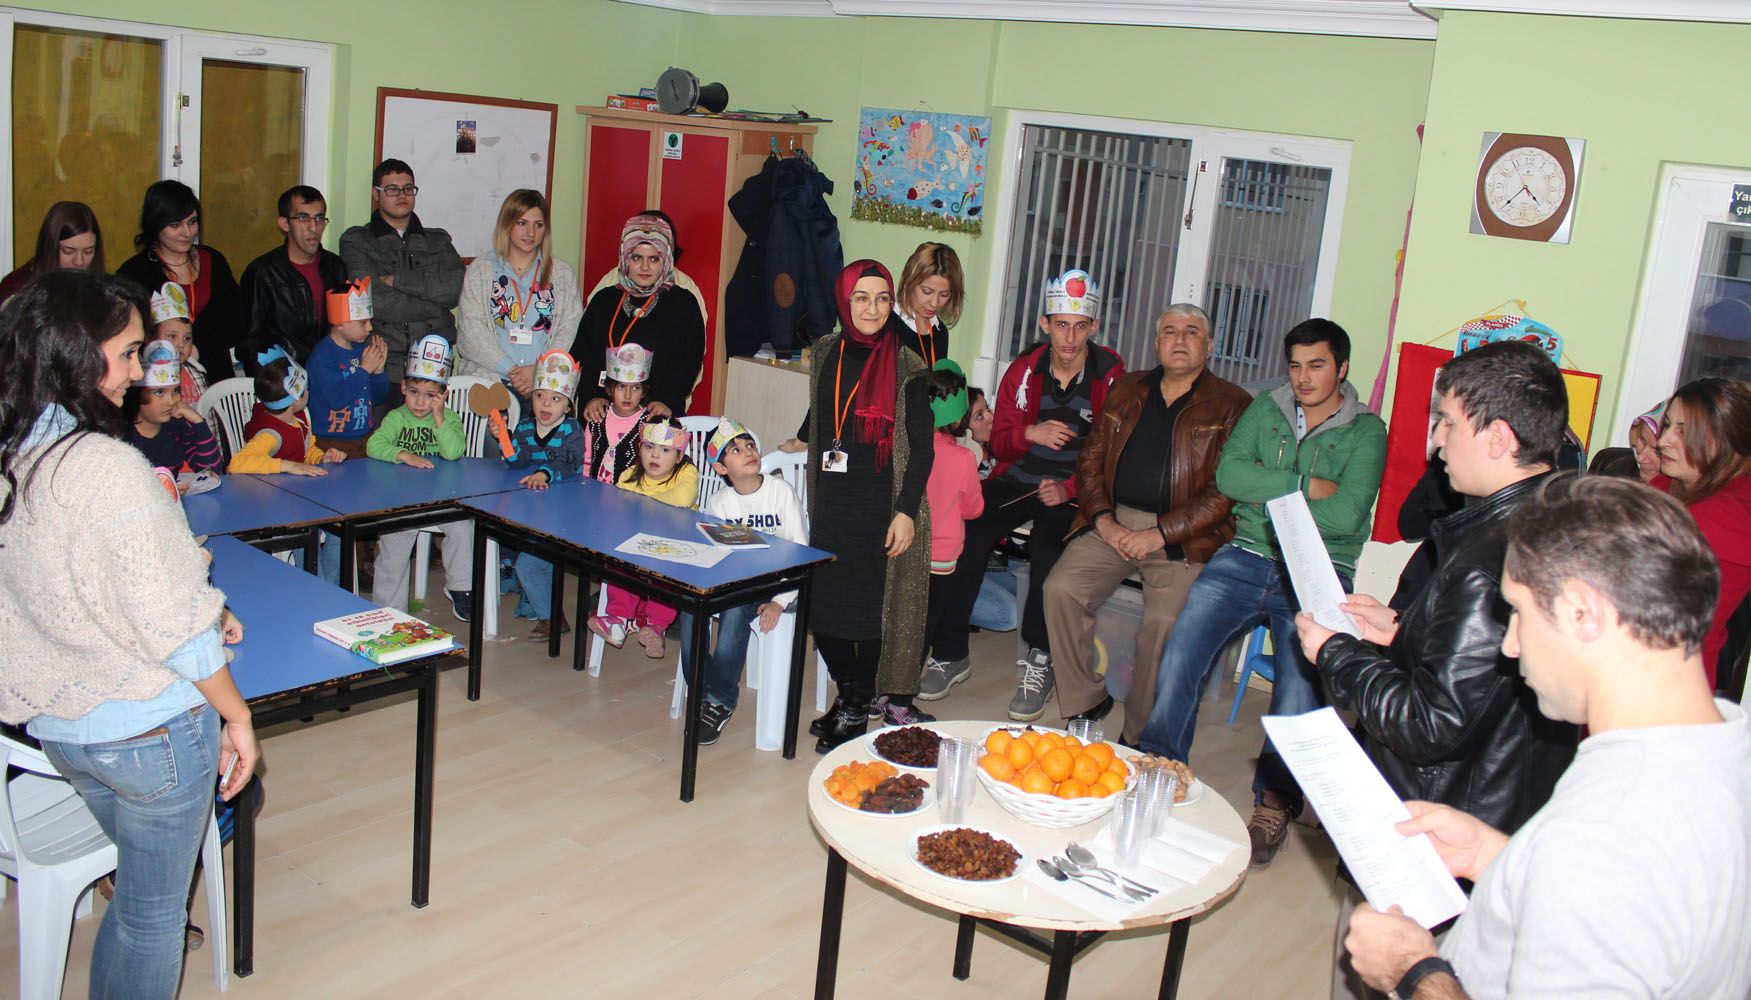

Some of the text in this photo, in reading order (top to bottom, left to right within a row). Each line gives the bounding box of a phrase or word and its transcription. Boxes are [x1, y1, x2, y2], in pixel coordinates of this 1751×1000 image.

[1545, 337, 1558, 351] 5
[399, 426, 437, 443] MUSI
[396, 440, 427, 451] FROM
